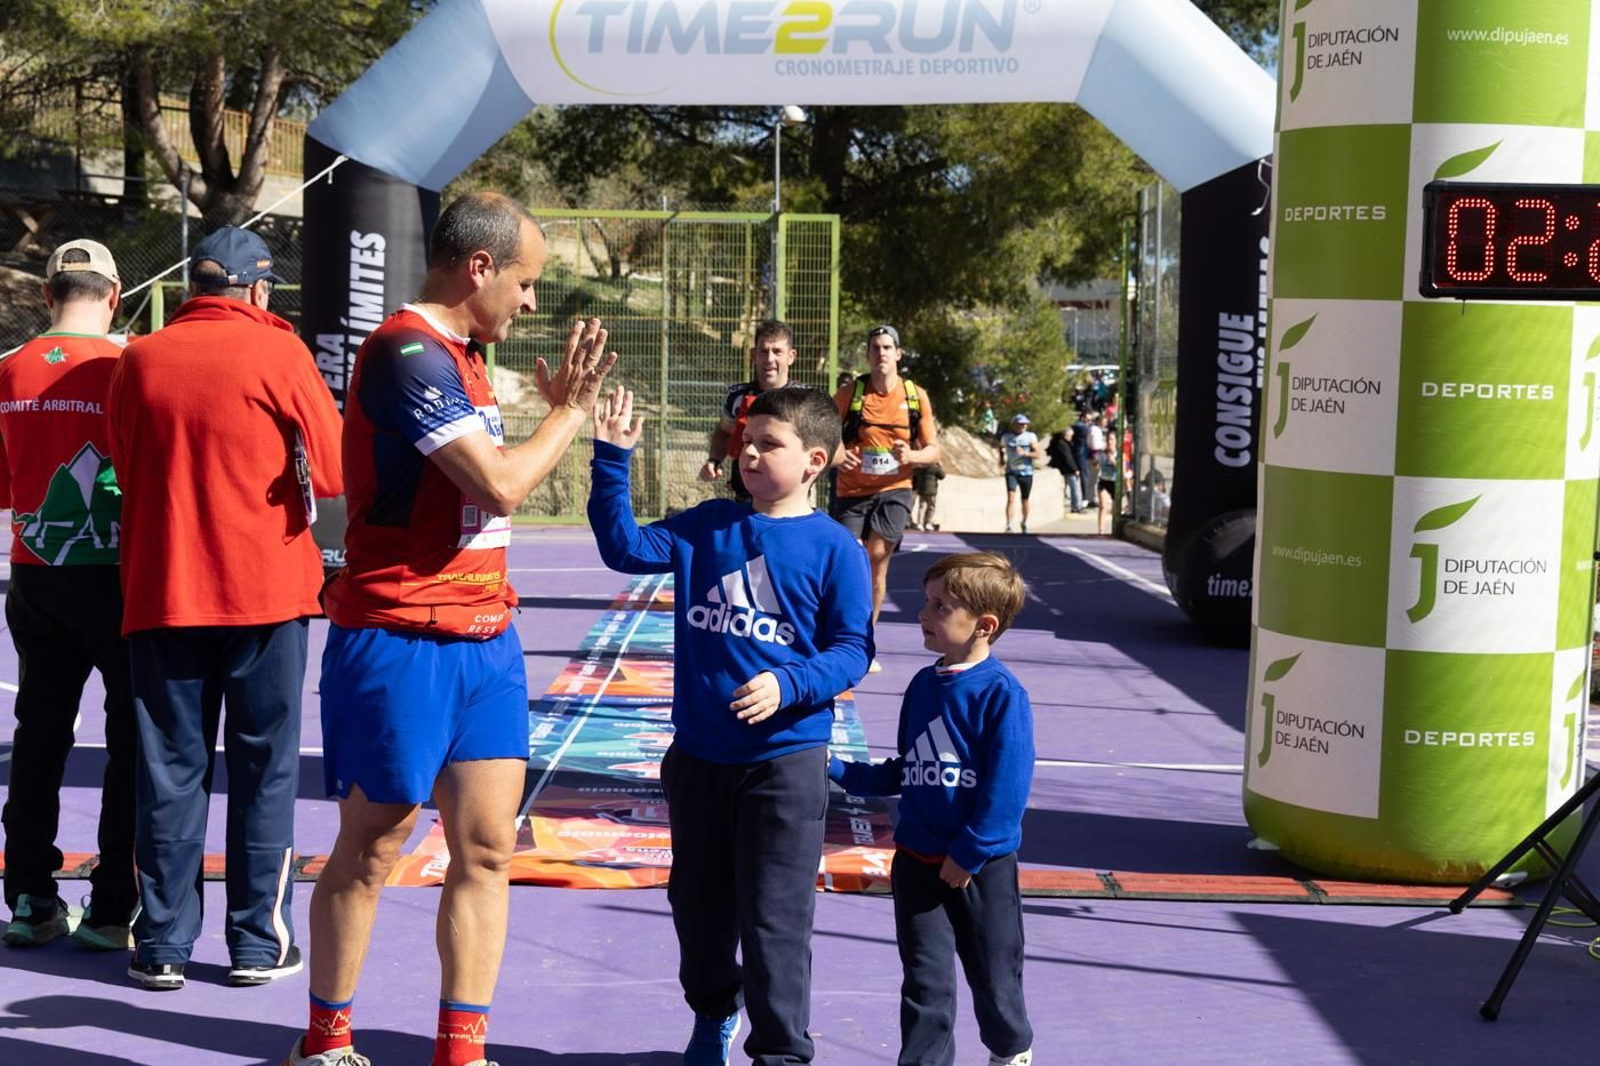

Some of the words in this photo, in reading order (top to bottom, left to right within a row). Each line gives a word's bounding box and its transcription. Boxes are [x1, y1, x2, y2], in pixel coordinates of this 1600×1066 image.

[573, 0, 1018, 55] TIME2RUN
[1308, 25, 1399, 48] DIPUTACIÓN
[1447, 27, 1570, 46] www.dipujaen.es
[774, 58, 915, 76] CRONOMETRAJE
[919, 57, 1019, 75] DEPORTIVO
[1307, 54, 1324, 69] DE
[1325, 49, 1362, 67] JAÉN
[1285, 205, 1386, 222] DEPORTES
[1447, 198, 1600, 282] 02:
[1214, 312, 1255, 468] CONSIGUE
[1292, 376, 1381, 395] DIPUTACIÓN
[1422, 382, 1554, 400] DEPORTES
[43, 400, 104, 414] ARBITRAL
[1291, 398, 1308, 412] DE
[1309, 398, 1345, 414] JAÉN
[1272, 545, 1362, 567] www.dipujaen.es
[1444, 558, 1547, 574] DIPUTACIÓN
[1443, 580, 1468, 595] DE
[1471, 578, 1515, 595] JAÉN
[687, 602, 796, 646] adidas
[1276, 710, 1365, 739] DIPUTACIÓN
[1275, 730, 1293, 746] DE
[1293, 736, 1329, 754] JAÉN
[1404, 730, 1536, 747] DEPORTES
[901, 761, 977, 789] adidas
